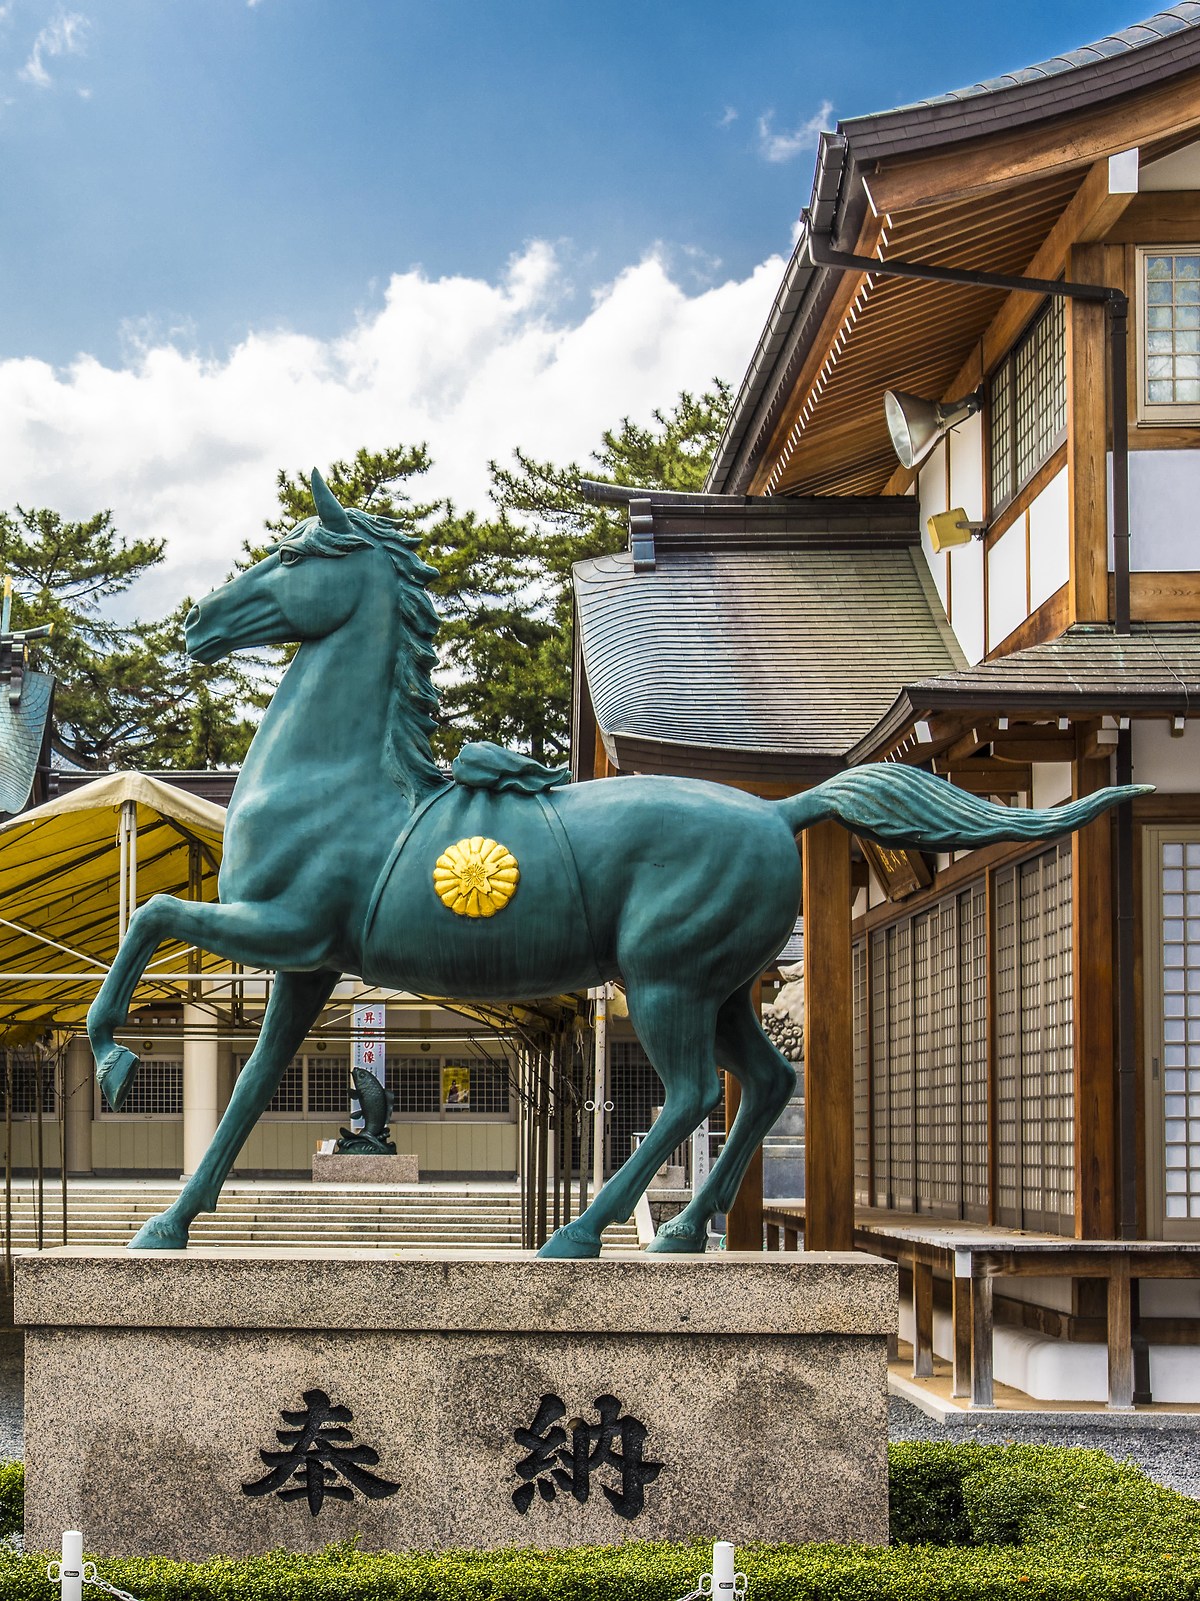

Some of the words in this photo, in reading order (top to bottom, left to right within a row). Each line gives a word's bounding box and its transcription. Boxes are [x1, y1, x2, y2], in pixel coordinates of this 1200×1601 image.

[363, 1011, 376, 1064] 昇の像
[241, 1388, 666, 1520] 奉納
